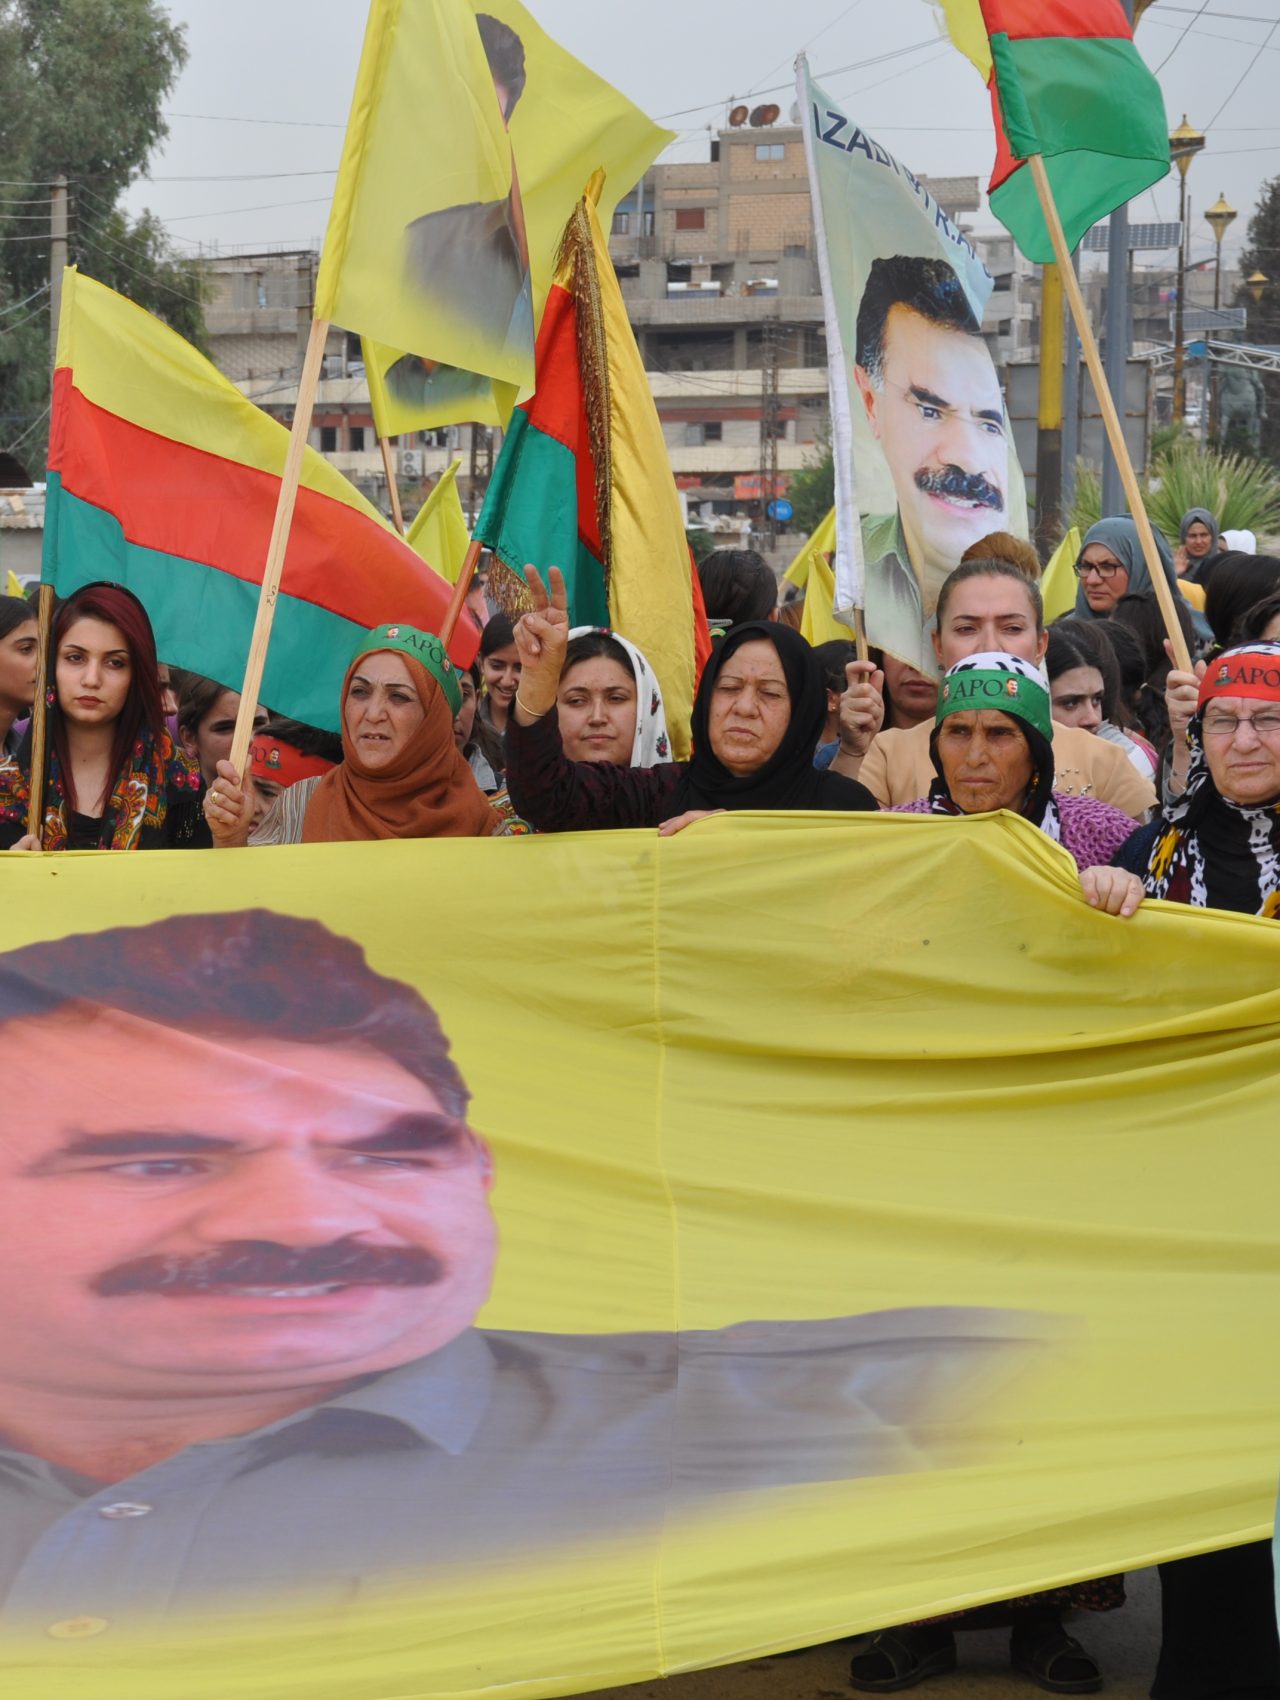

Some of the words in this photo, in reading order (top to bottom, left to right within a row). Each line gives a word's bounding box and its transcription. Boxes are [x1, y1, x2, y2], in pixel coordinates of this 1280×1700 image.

[403, 633, 444, 664] APO
[1232, 665, 1280, 688] APO
[953, 679, 1004, 700] APO
